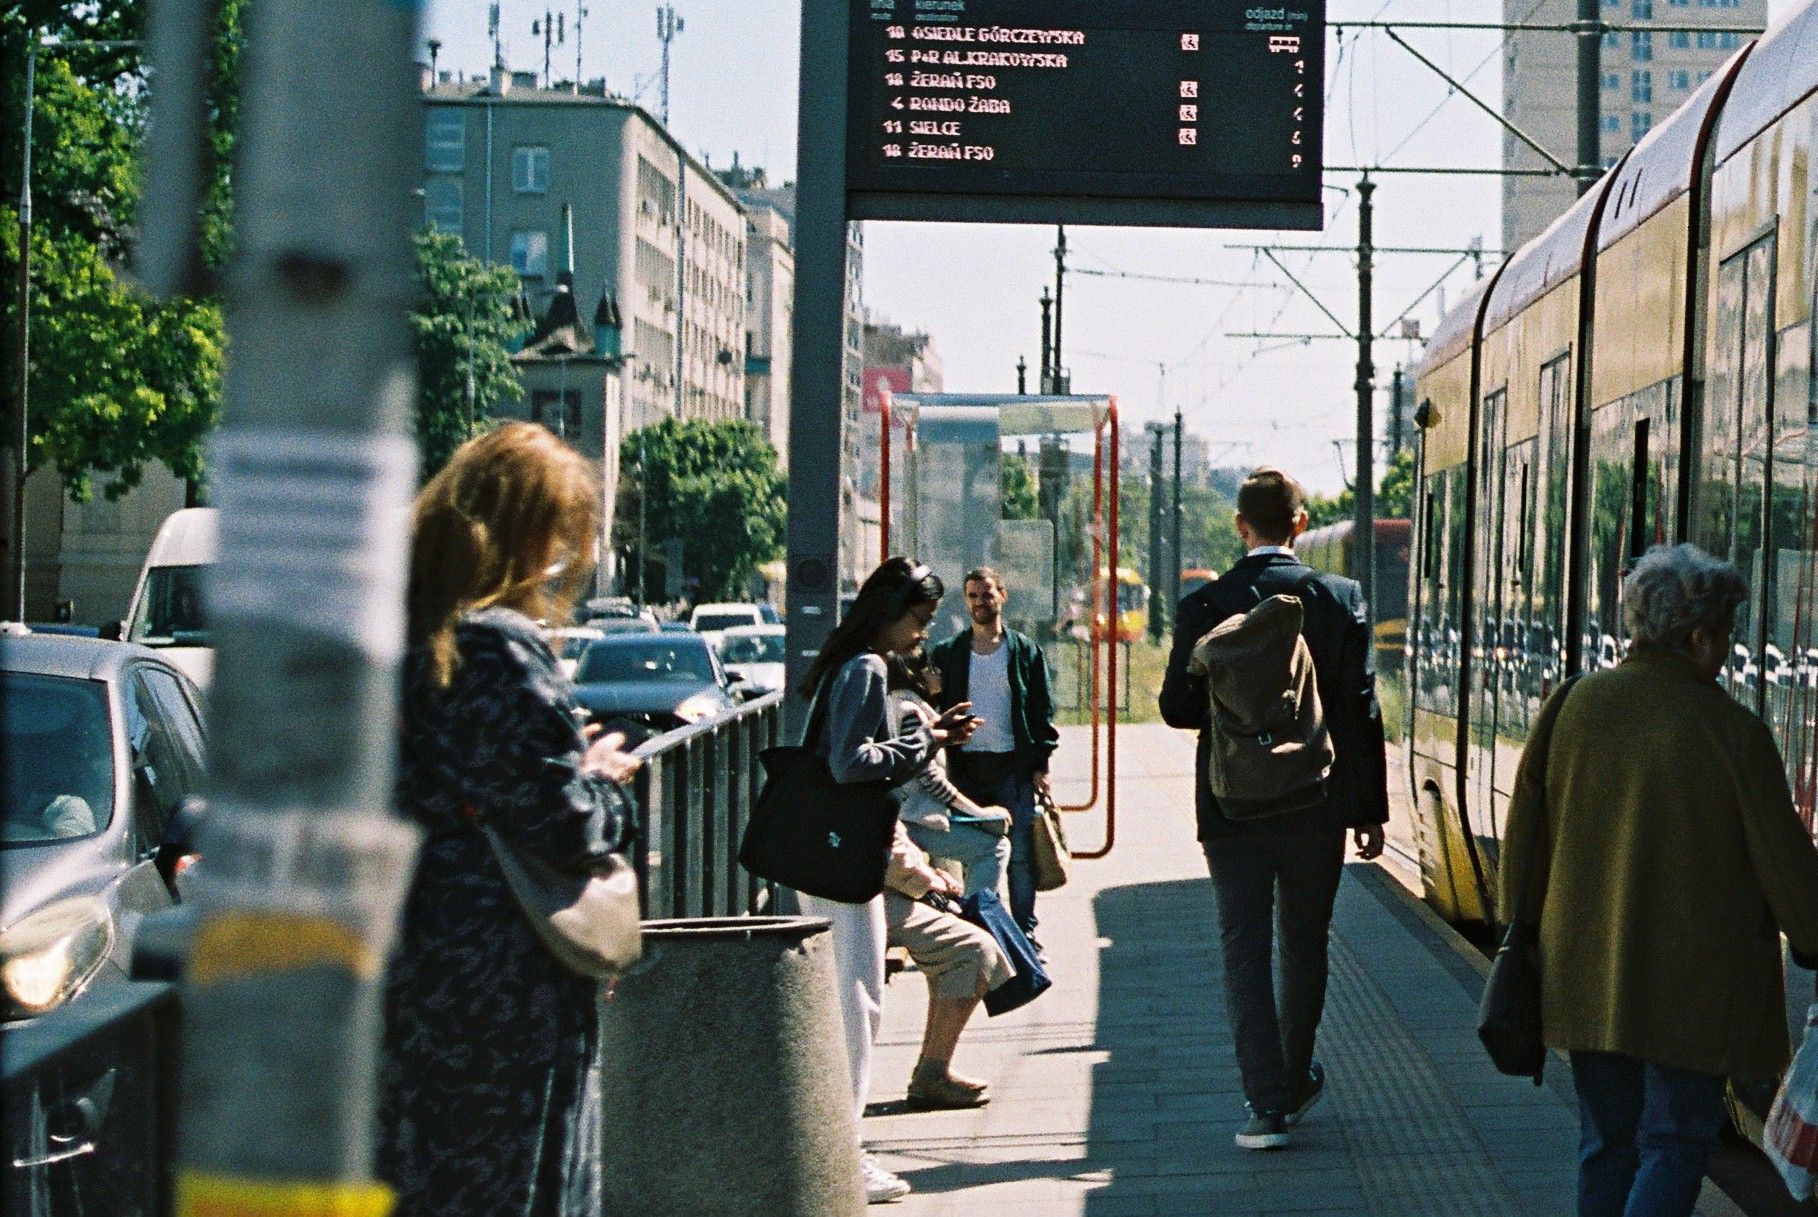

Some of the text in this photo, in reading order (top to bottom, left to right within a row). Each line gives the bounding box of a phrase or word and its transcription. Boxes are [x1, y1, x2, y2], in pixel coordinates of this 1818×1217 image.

[1245, 7, 1285, 22] odjazd
[912, 27, 975, 42] OSIEDLE
[979, 26, 1085, 45] GÓRCZEWSKA
[885, 50, 905, 62] 15
[966, 75, 996, 90] FSO
[909, 97, 965, 112] RONDO
[968, 96, 1011, 114] ŻABA
[883, 121, 902, 133] 11
[909, 121, 962, 136] SIELCE
[964, 145, 994, 161] FSO
